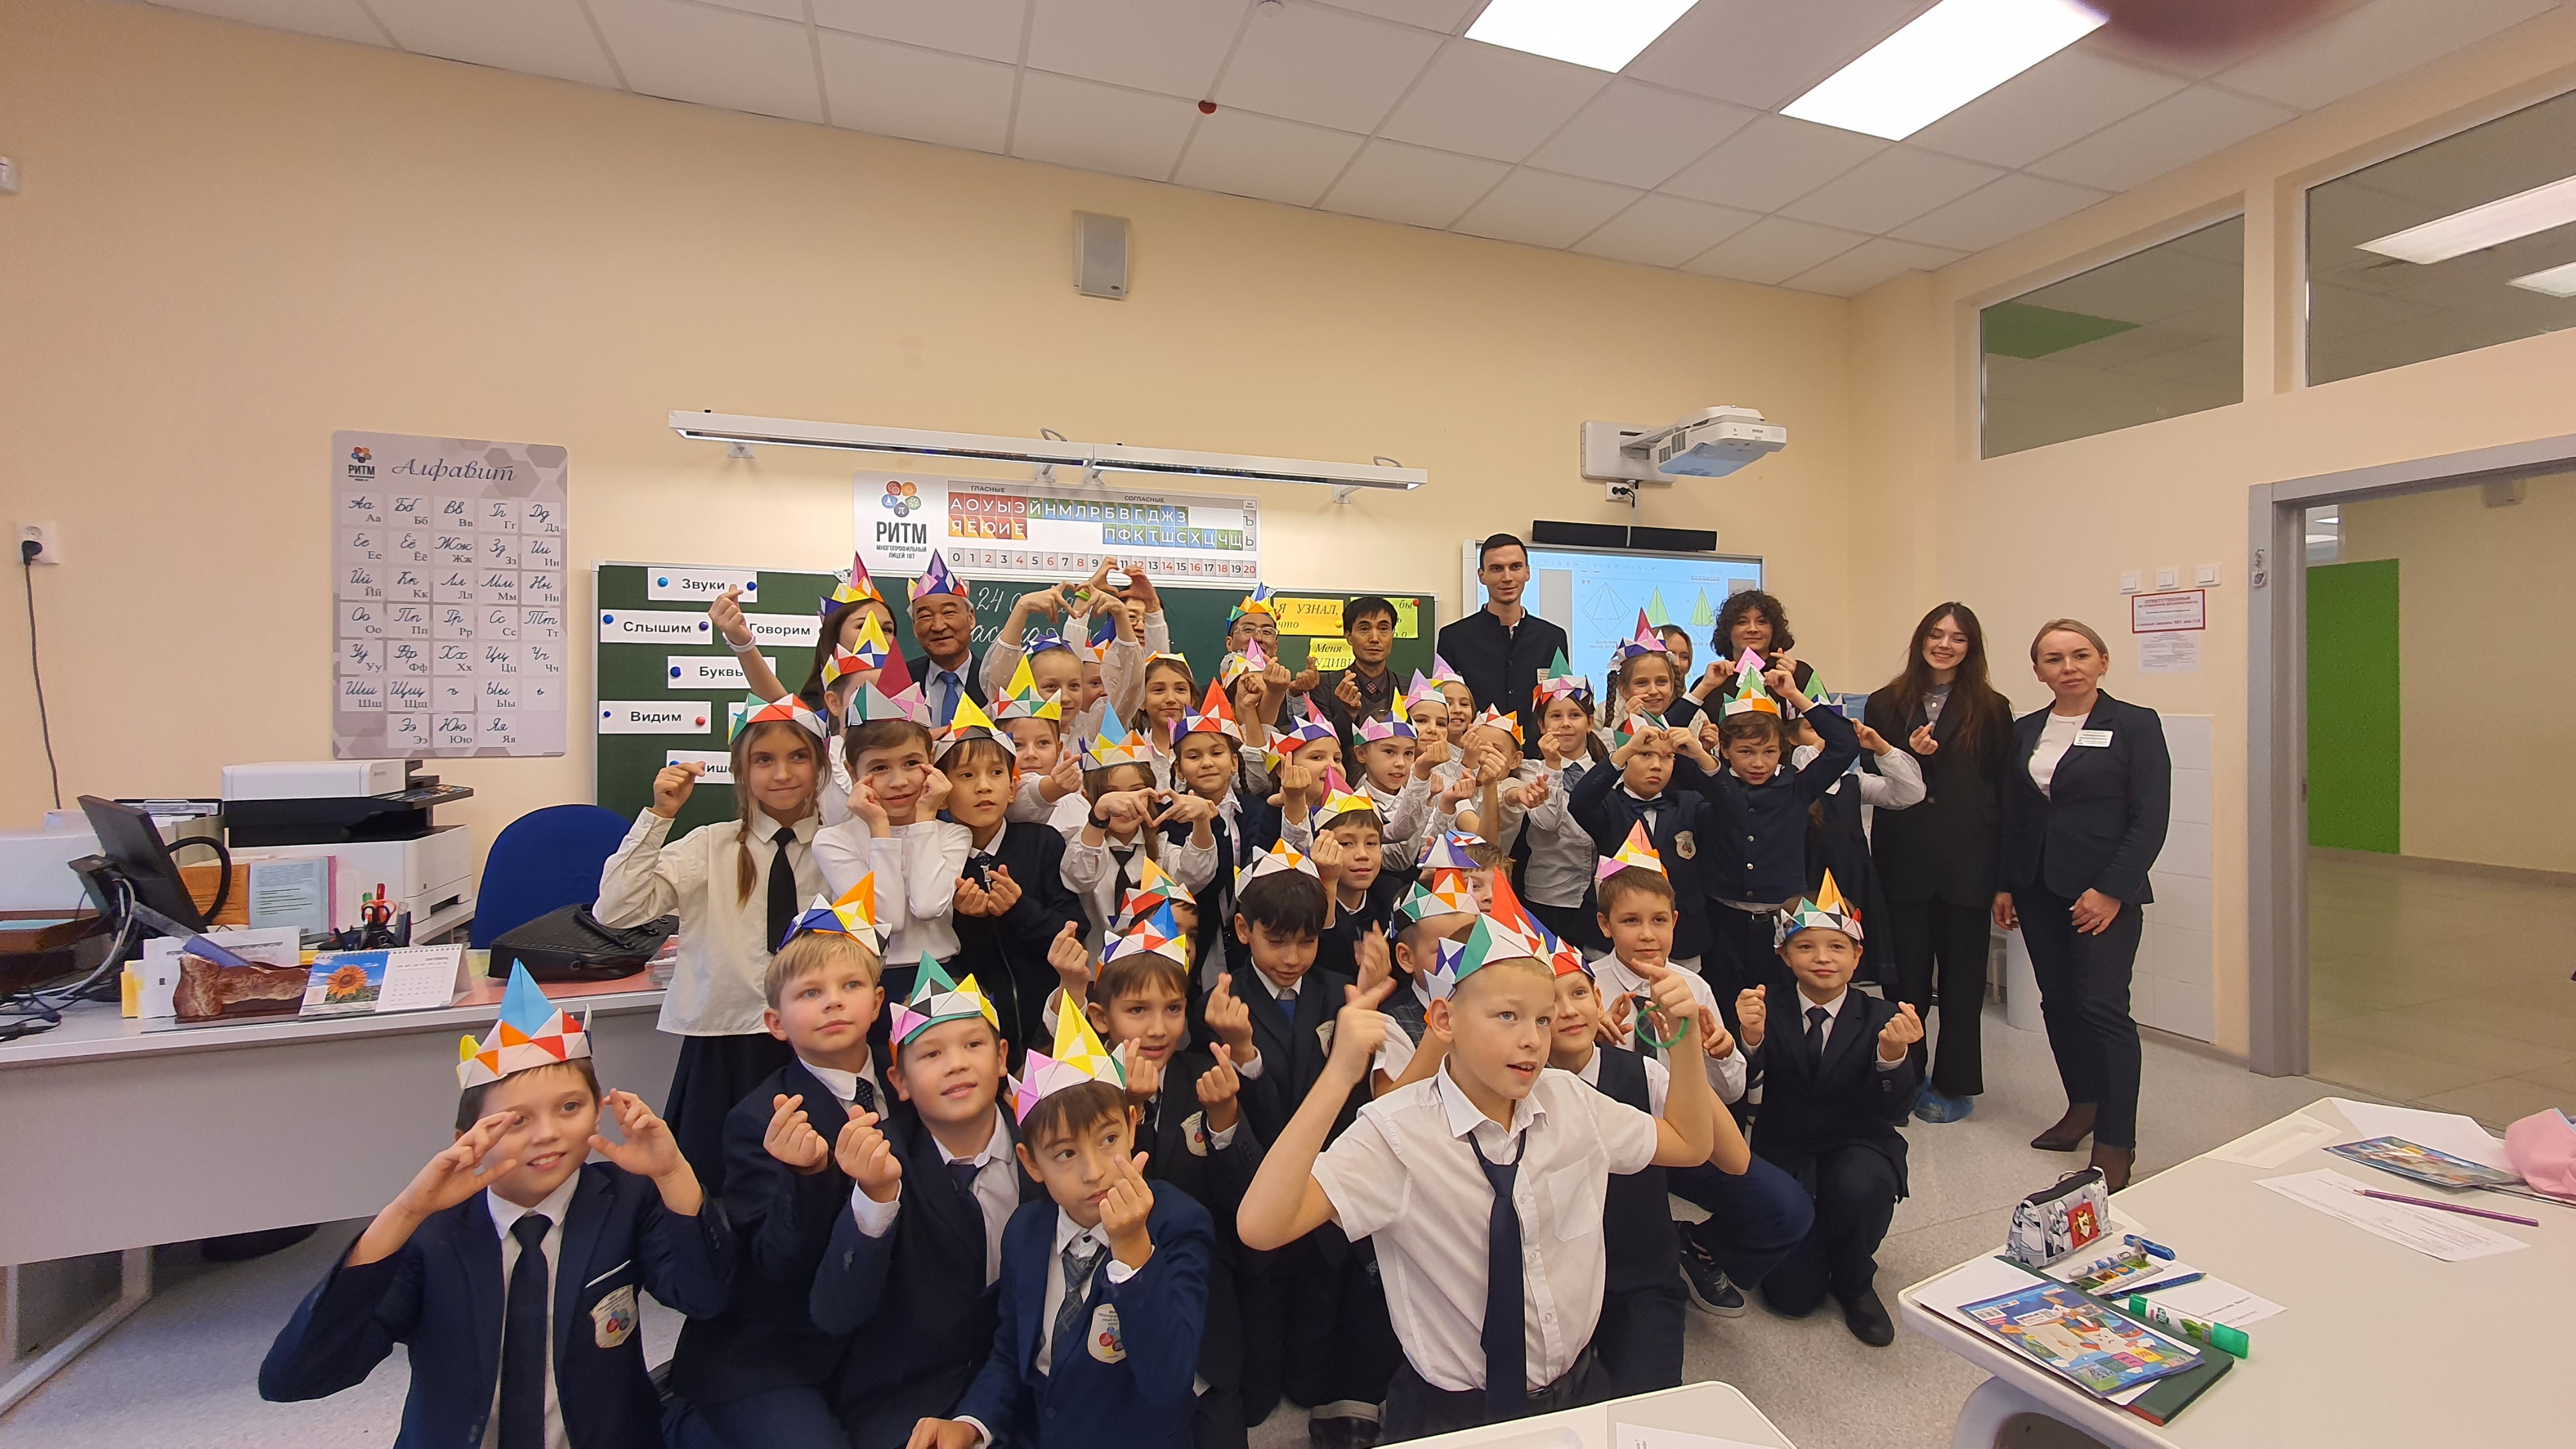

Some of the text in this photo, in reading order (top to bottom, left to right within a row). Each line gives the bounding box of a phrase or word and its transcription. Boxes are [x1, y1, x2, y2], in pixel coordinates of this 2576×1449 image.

[348, 464, 375, 475] РИТМ
[392, 458, 518, 481] Алфавит
[348, 496, 550, 523] Аа Бб Вв Гг Дд
[951, 498, 1186, 523] А О У Ы Э Й Н М Л Р Б В Г Д Ж З
[415, 516, 428, 525] Бб
[545, 524, 560, 532] Дд
[952, 519, 1023, 535] Я Ё Ю И Е
[877, 521, 926, 544] РИТМ
[1105, 528, 1242, 548] П Ф К Т Ш С Х Ц Ч Щ
[353, 533, 551, 558] Ее Ёё Жж Зз Ии
[367, 551, 382, 560] Ее
[415, 551, 428, 561] Ёё
[452, 555, 473, 563] Жж
[953, 553, 960, 562] 0
[970, 553, 974, 562] 1
[1000, 555, 1007, 564] 3
[1016, 556, 1023, 564] 4
[1031, 556, 1038, 565] 5
[1047, 557, 1054, 565] 6
[1062, 558, 1069, 566] 7
[1077, 558, 1084, 567] 8
[1092, 559, 1098, 567] 9
[1190, 563, 1200, 571] 16
[1232, 565, 1241, 573] 19
[350, 568, 553, 589] Йй Кк Лл Мм Нн
[681, 578, 725, 592] Звуки
[365, 586, 381, 597] Йй
[413, 590, 428, 598] Кк
[498, 592, 516, 601] Мм
[976, 586, 1004, 612] 24
[1278, 603, 1338, 615] Я УЗНАЛ,
[1399, 599, 1412, 609] бы
[351, 607, 558, 626] Оо Пп Рр Сс Тт
[365, 625, 381, 633] Оо
[412, 626, 428, 634] Пп
[459, 627, 472, 638] Рр
[546, 629, 559, 637] Тт
[623, 620, 691, 635] Слышим
[749, 624, 810, 636] Говорим
[1278, 620, 1299, 629] что
[349, 644, 549, 663] Уу Фф Хх Цц Чч
[1314, 643, 1342, 653] Меня
[365, 663, 382, 673] Уу
[409, 663, 427, 673] Фф
[457, 663, 472, 671] Хх
[502, 664, 516, 673] Цц
[346, 681, 378, 695] Шш
[390, 682, 425, 698] Щщ
[487, 682, 510, 695] Ыы
[404, 700, 427, 709] Щщ
[399, 717, 509, 732] Ээ Юю Яя
[630, 710, 682, 724] Видим
[450, 735, 472, 744] Юю
